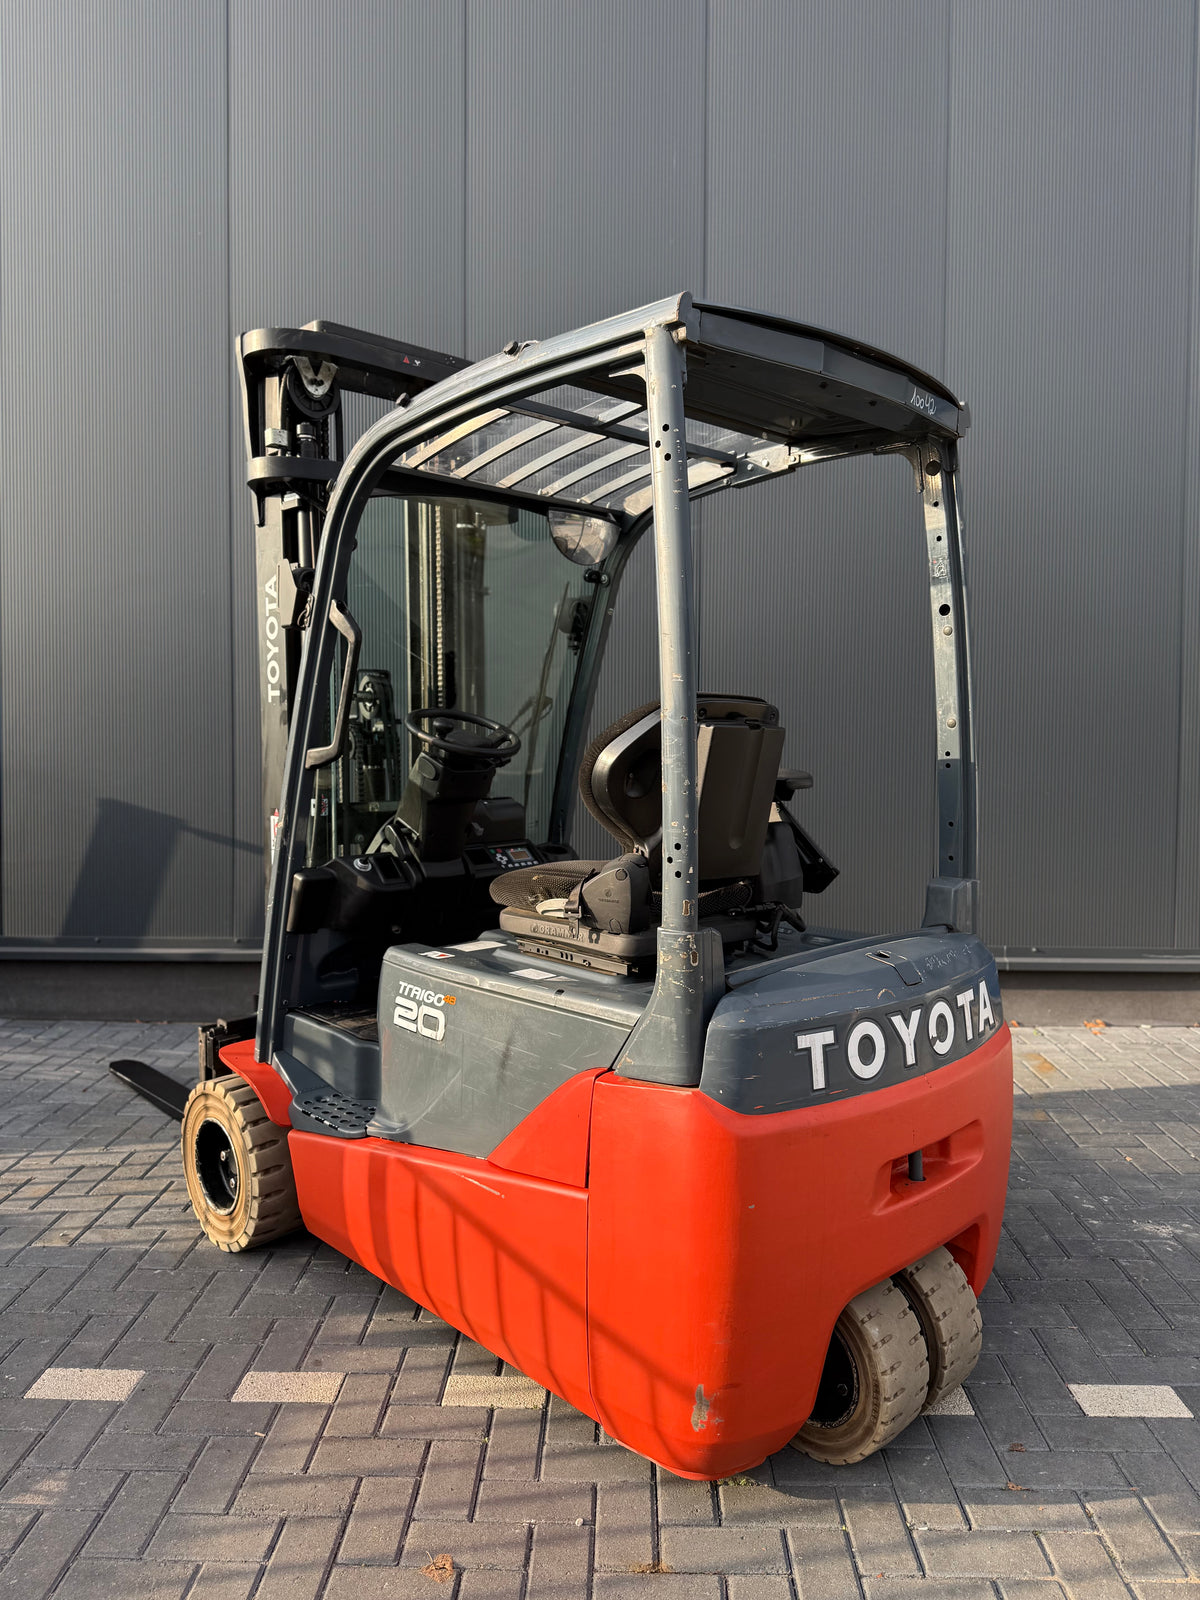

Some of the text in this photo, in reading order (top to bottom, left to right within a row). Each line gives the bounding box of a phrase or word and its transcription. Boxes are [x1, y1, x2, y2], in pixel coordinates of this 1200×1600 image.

[264, 574, 281, 703] TOYOTA
[393, 996, 446, 1041] 20
[797, 979, 995, 1090] TOYOTA
